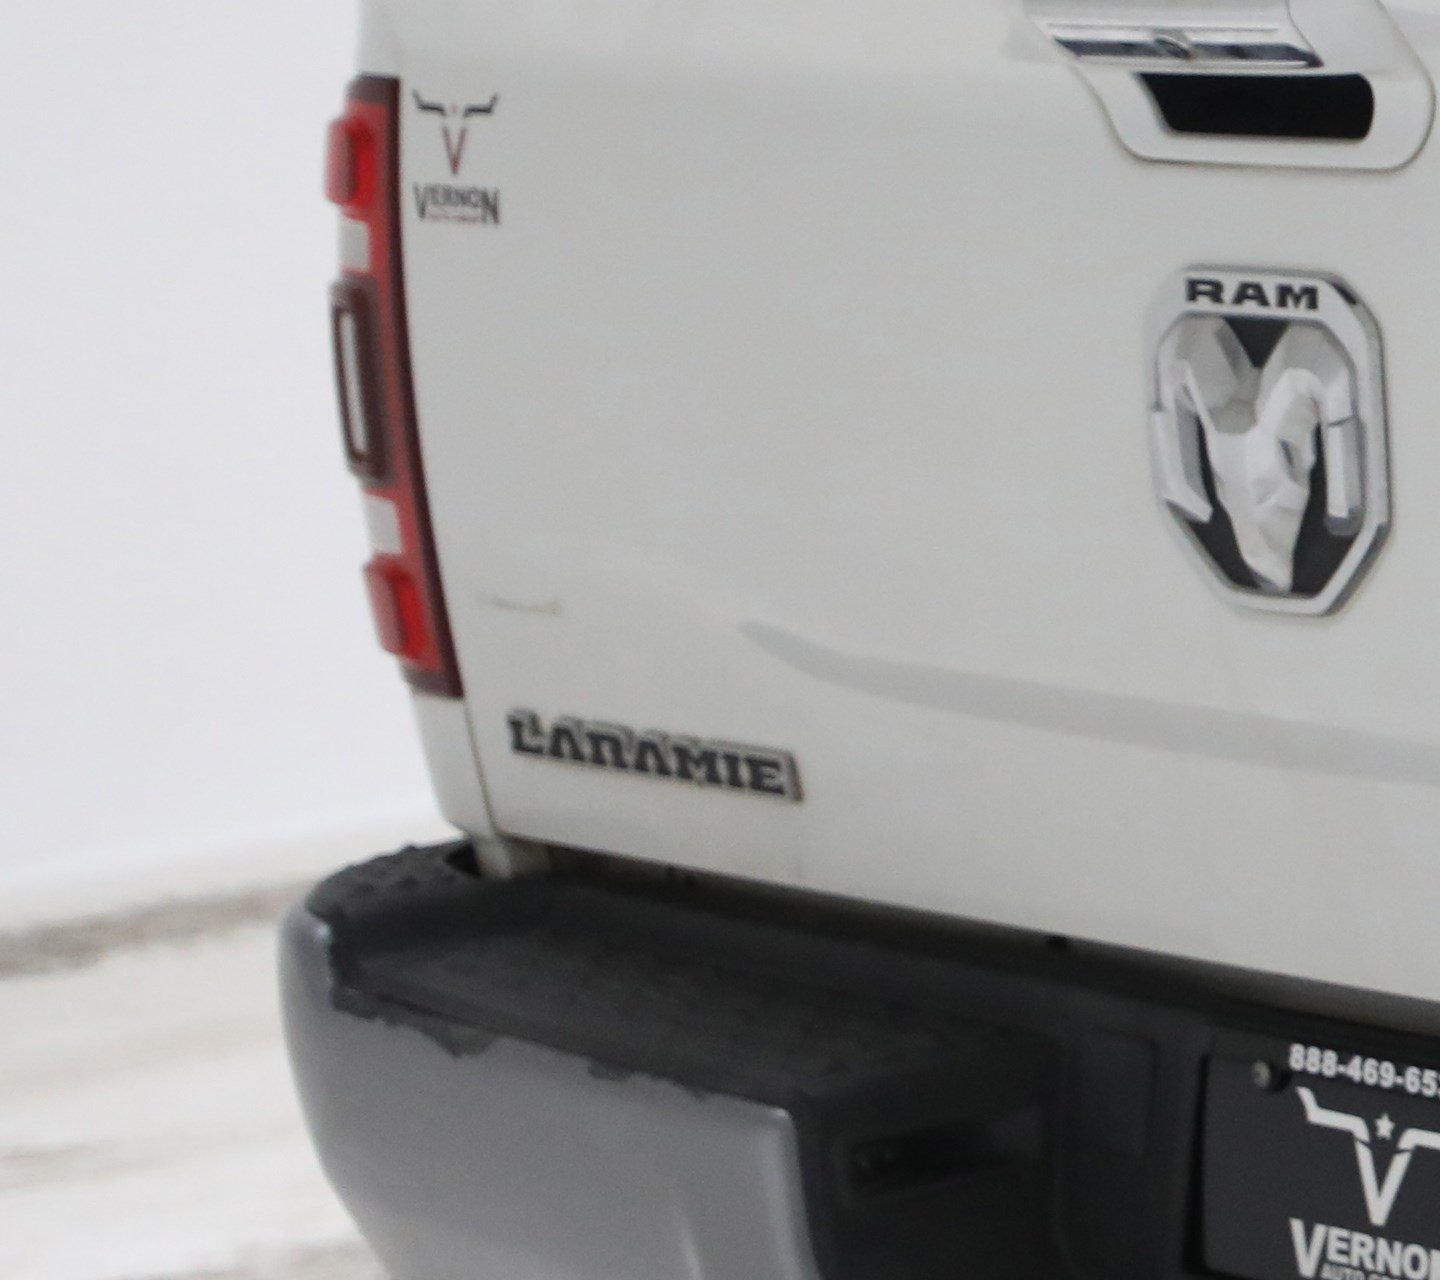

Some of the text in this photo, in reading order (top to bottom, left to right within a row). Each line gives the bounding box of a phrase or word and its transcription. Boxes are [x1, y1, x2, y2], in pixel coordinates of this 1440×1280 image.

[412, 181, 501, 225] VERNON
[1185, 278, 1319, 310] RAM
[506, 708, 804, 801] LARAMIE
